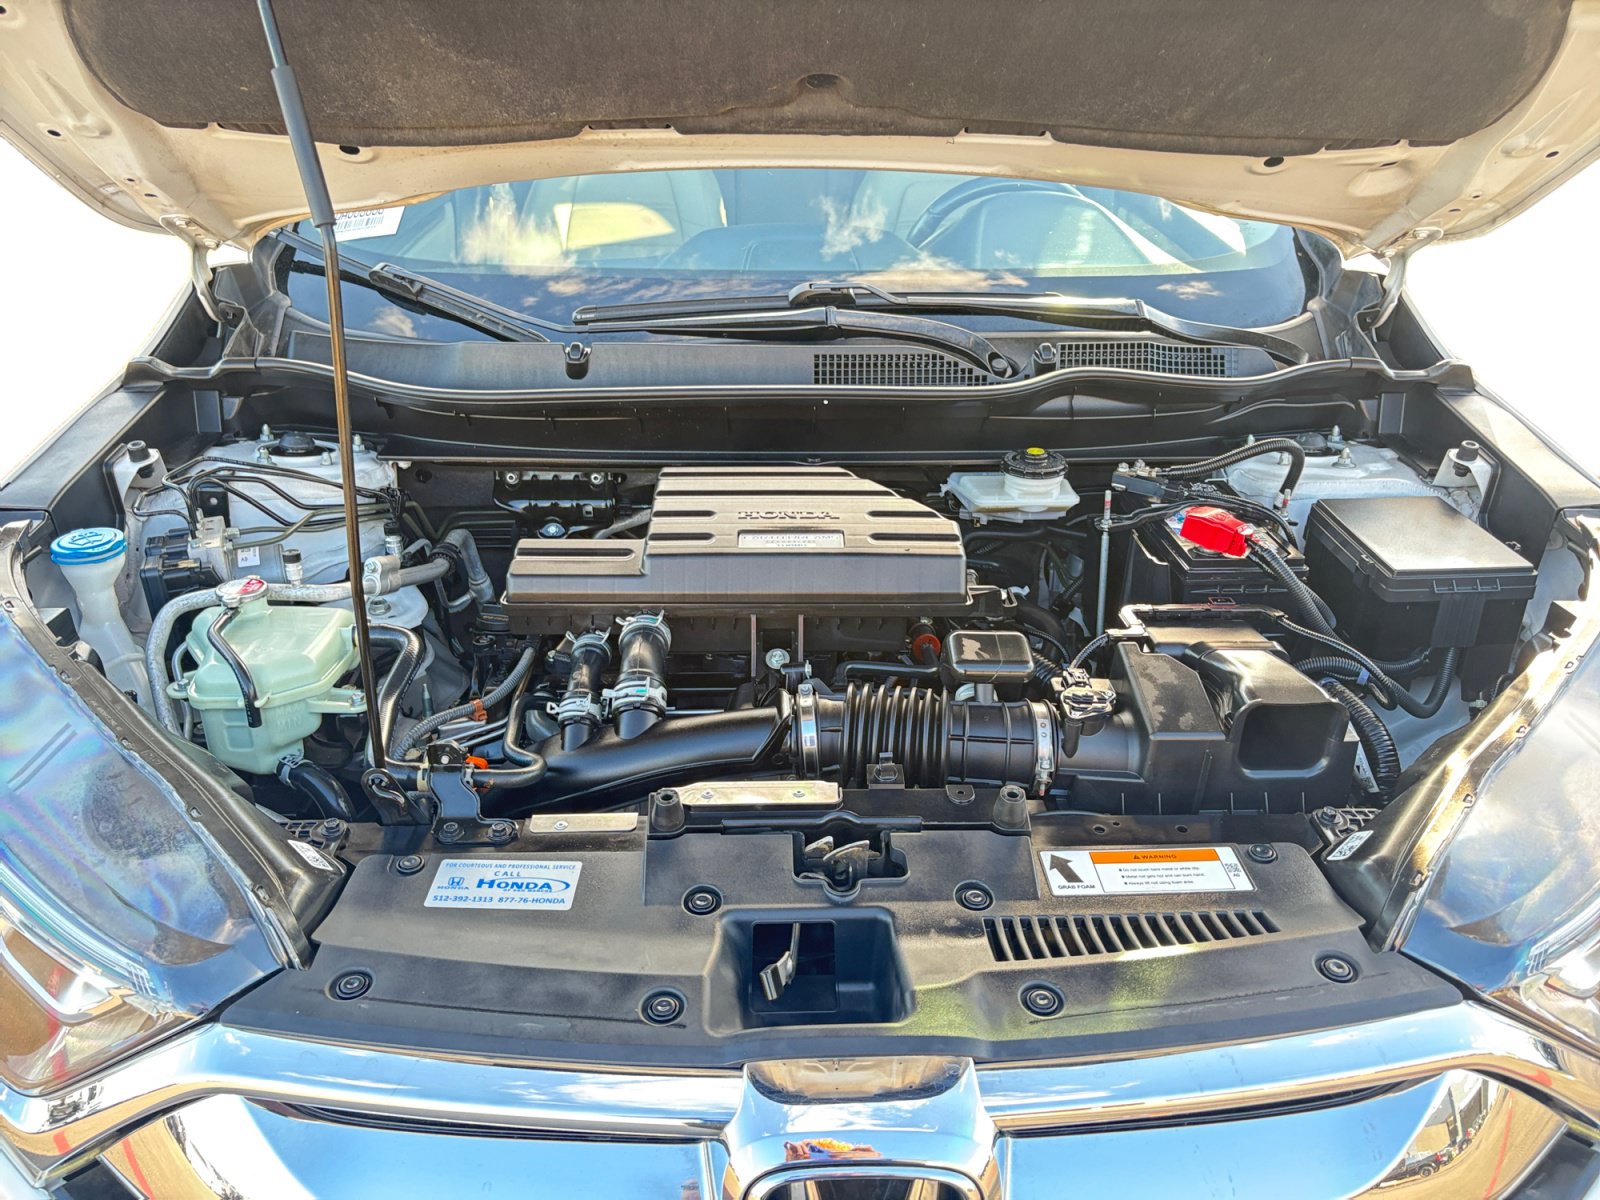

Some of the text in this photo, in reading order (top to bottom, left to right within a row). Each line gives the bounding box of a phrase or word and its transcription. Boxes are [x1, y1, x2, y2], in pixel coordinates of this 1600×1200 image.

[737, 511, 840, 520] HONDA
[475, 878, 553, 890] HONDA
[432, 894, 566, 905] 512-392-1313 877-76-HONDA
